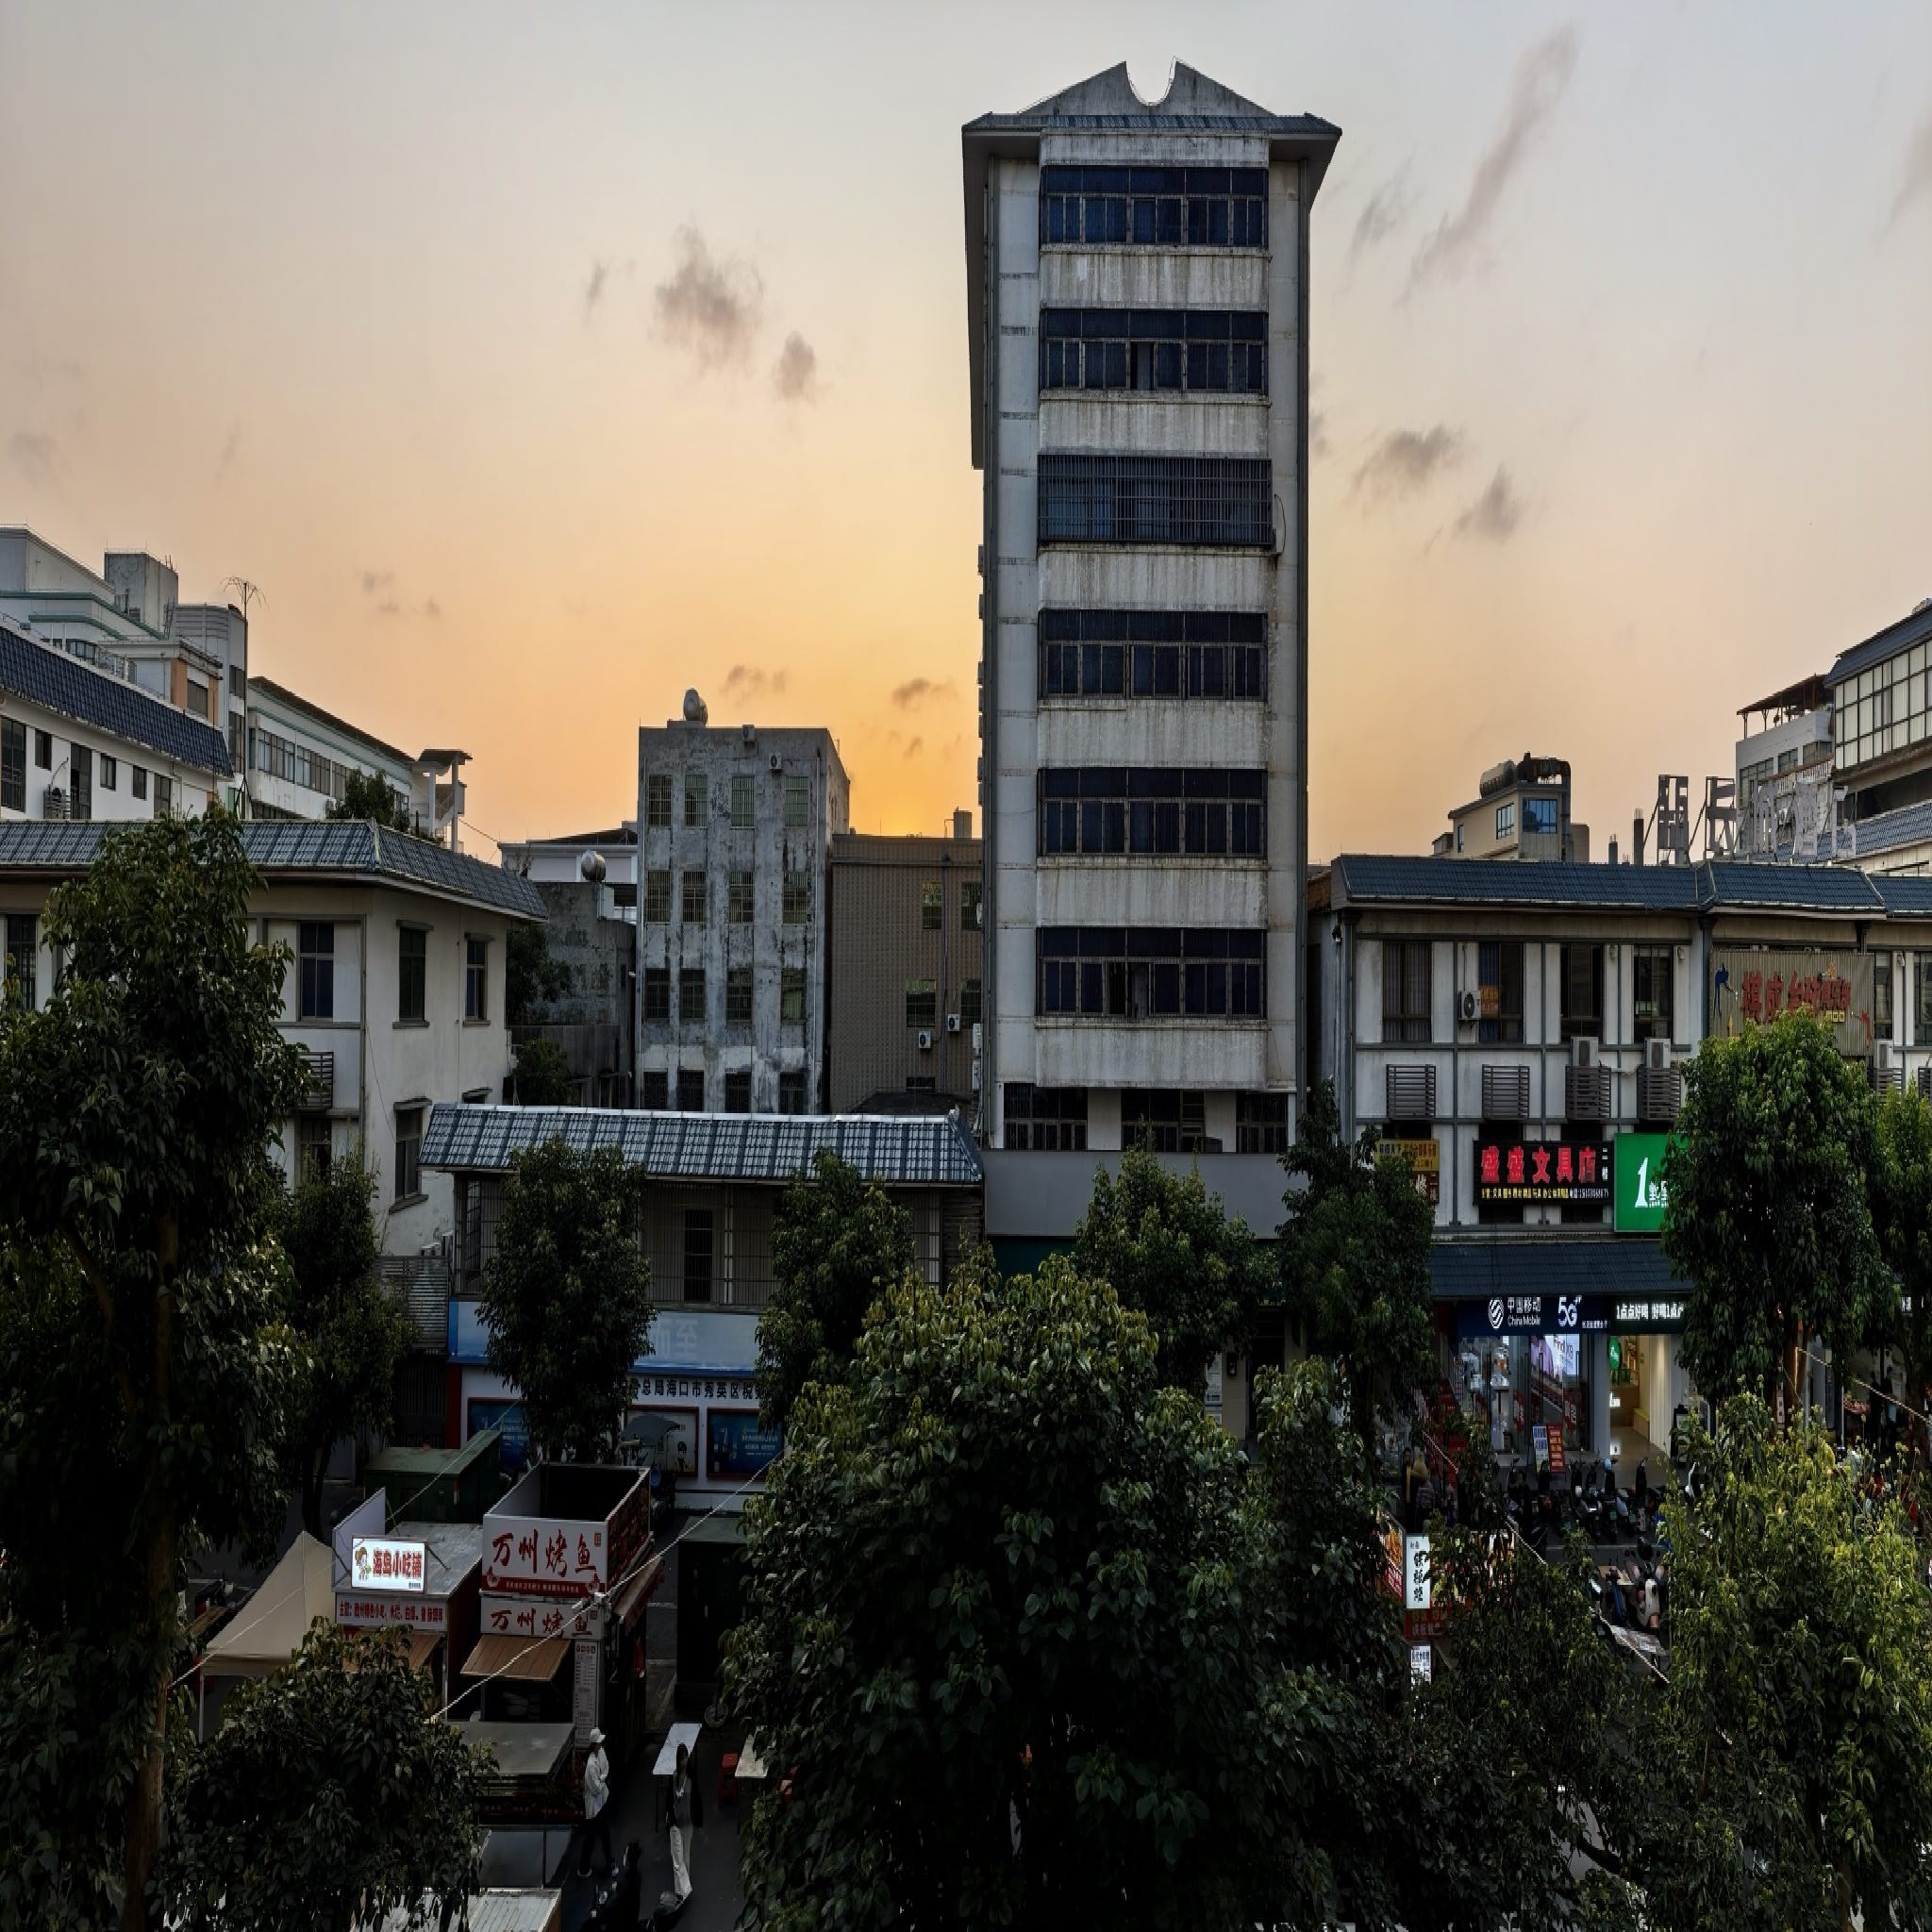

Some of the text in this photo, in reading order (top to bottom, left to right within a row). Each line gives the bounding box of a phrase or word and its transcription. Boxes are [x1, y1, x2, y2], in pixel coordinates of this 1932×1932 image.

[1481, 1145, 1596, 1184] 盛盛文具店
[1507, 1296, 1541, 1313] 中国移动
[1507, 1314, 1541, 1326] China Mobile
[492, 1528, 596, 1578] 万州烤鱼
[491, 1607, 592, 1639] 万州烤鱼
